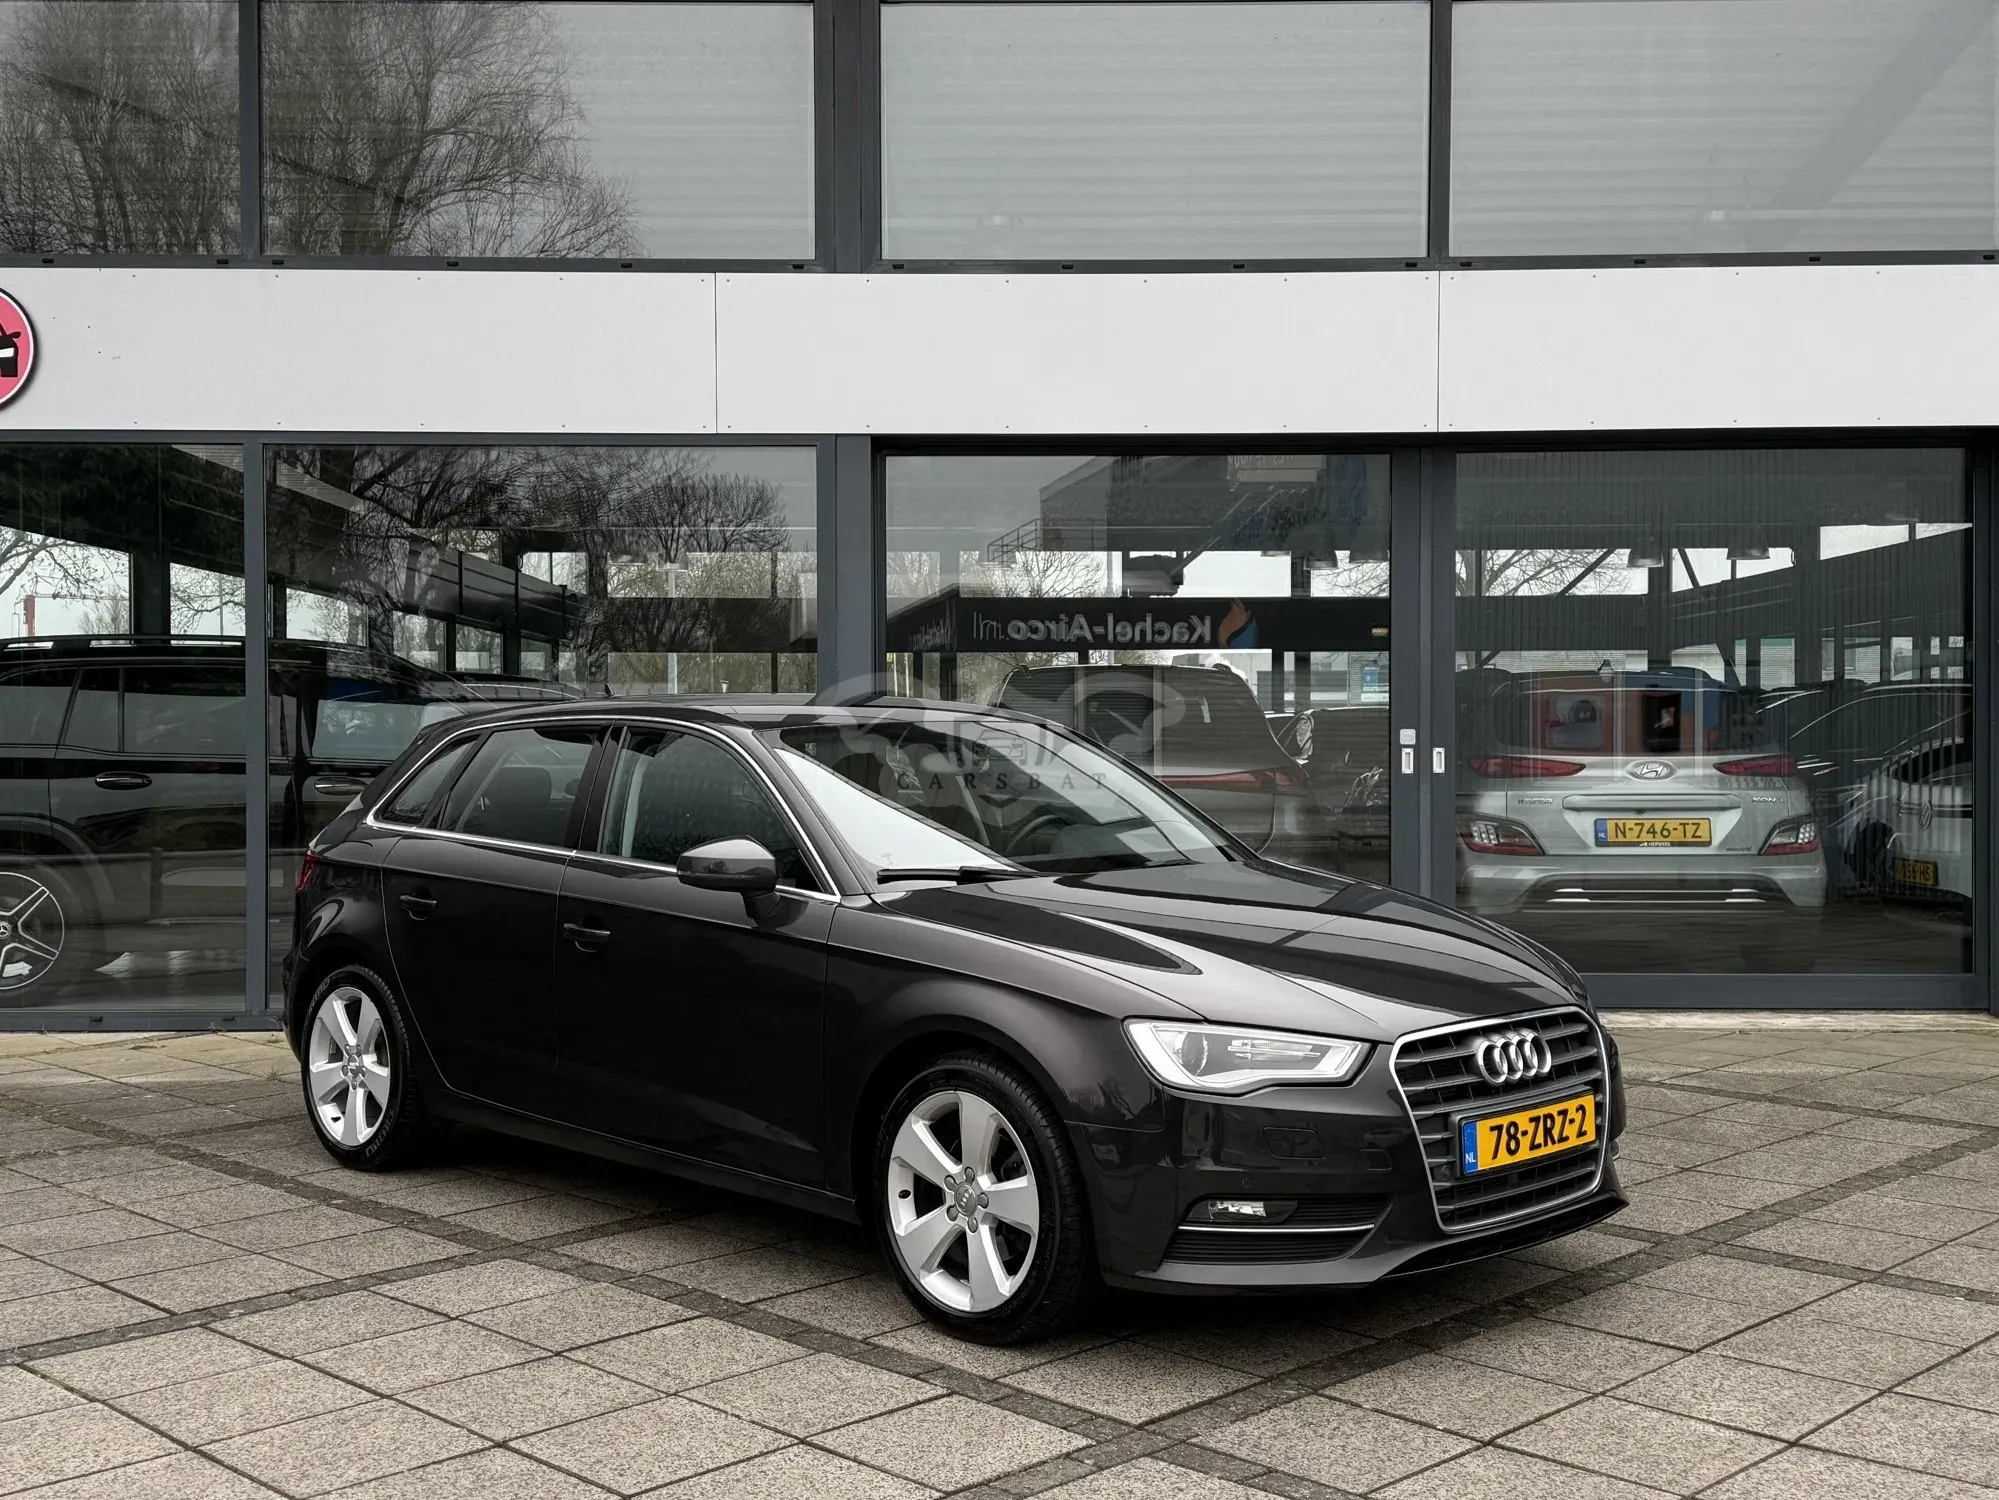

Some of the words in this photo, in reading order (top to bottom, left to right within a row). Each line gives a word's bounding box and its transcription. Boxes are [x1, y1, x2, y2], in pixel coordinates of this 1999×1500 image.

[1614, 822, 1702, 839] N-746-TZ
[1489, 1103, 1589, 1161] 78-ZRZ-2
[1465, 1151, 1477, 1164] NL
